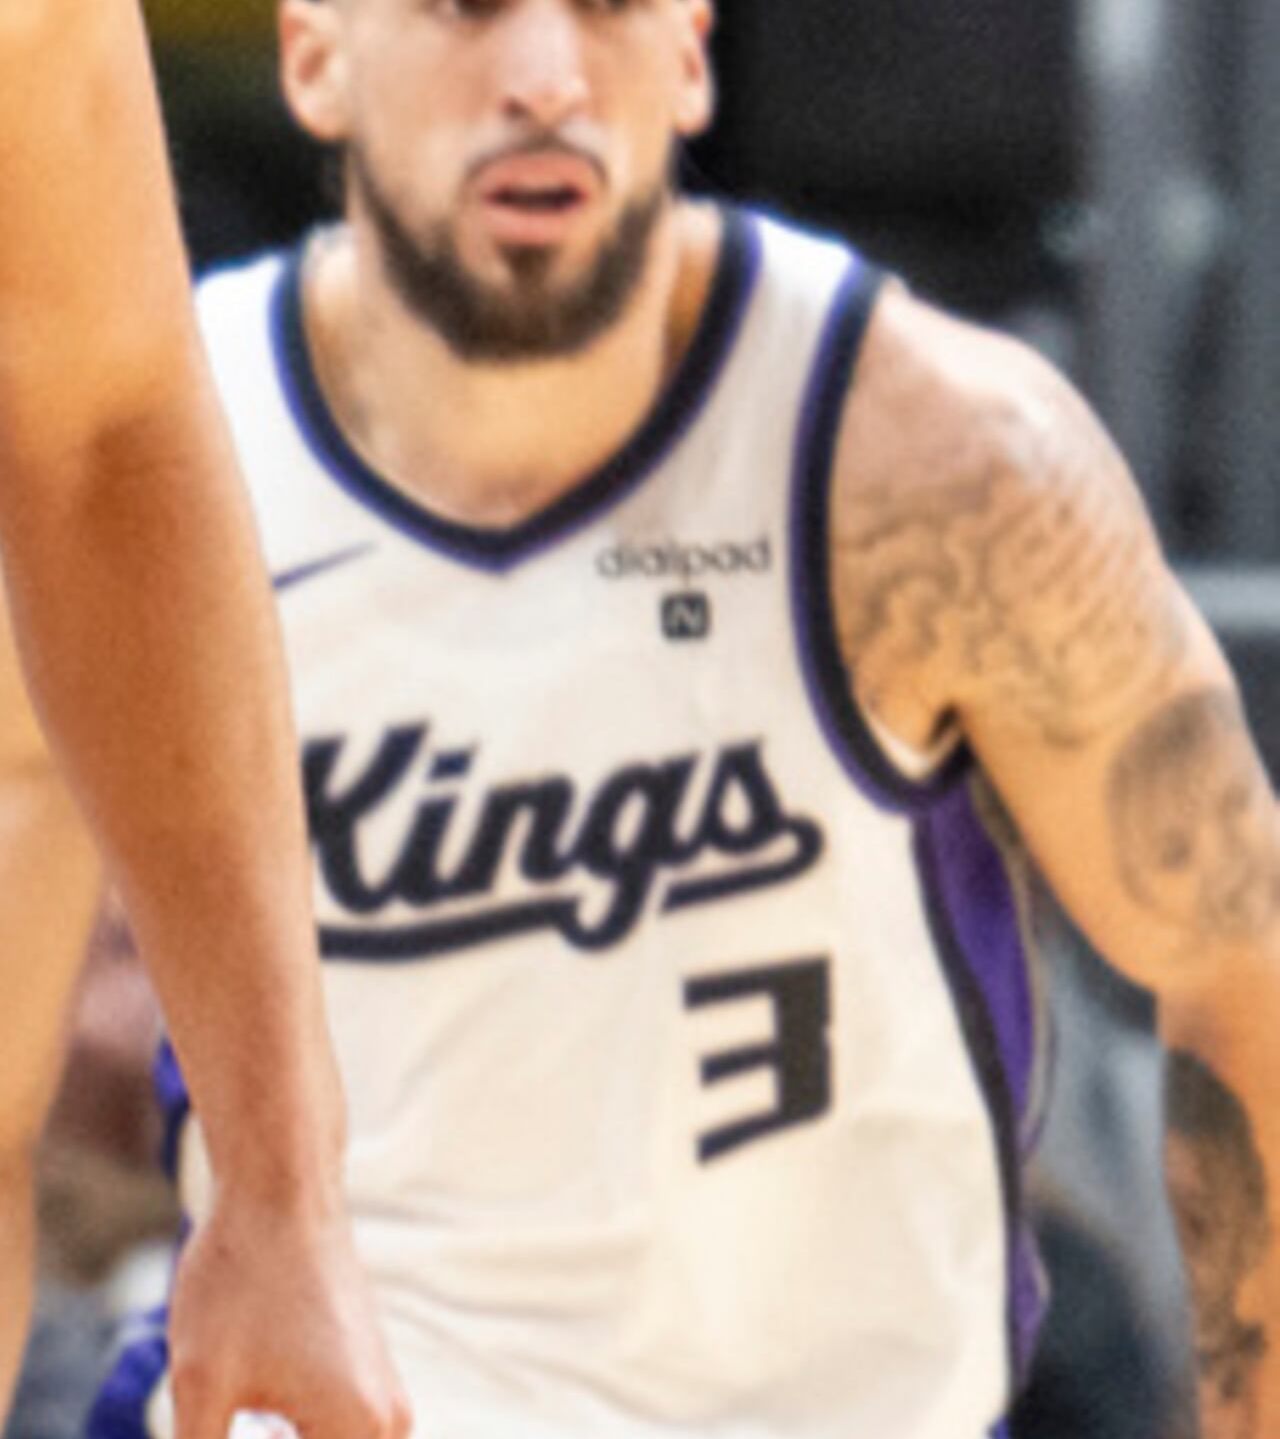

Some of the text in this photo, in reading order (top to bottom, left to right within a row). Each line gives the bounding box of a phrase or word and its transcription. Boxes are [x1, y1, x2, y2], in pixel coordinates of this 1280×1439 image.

[595, 534, 772, 589] dialpad
[299, 718, 824, 961] Kings
[682, 953, 834, 1167] 3
